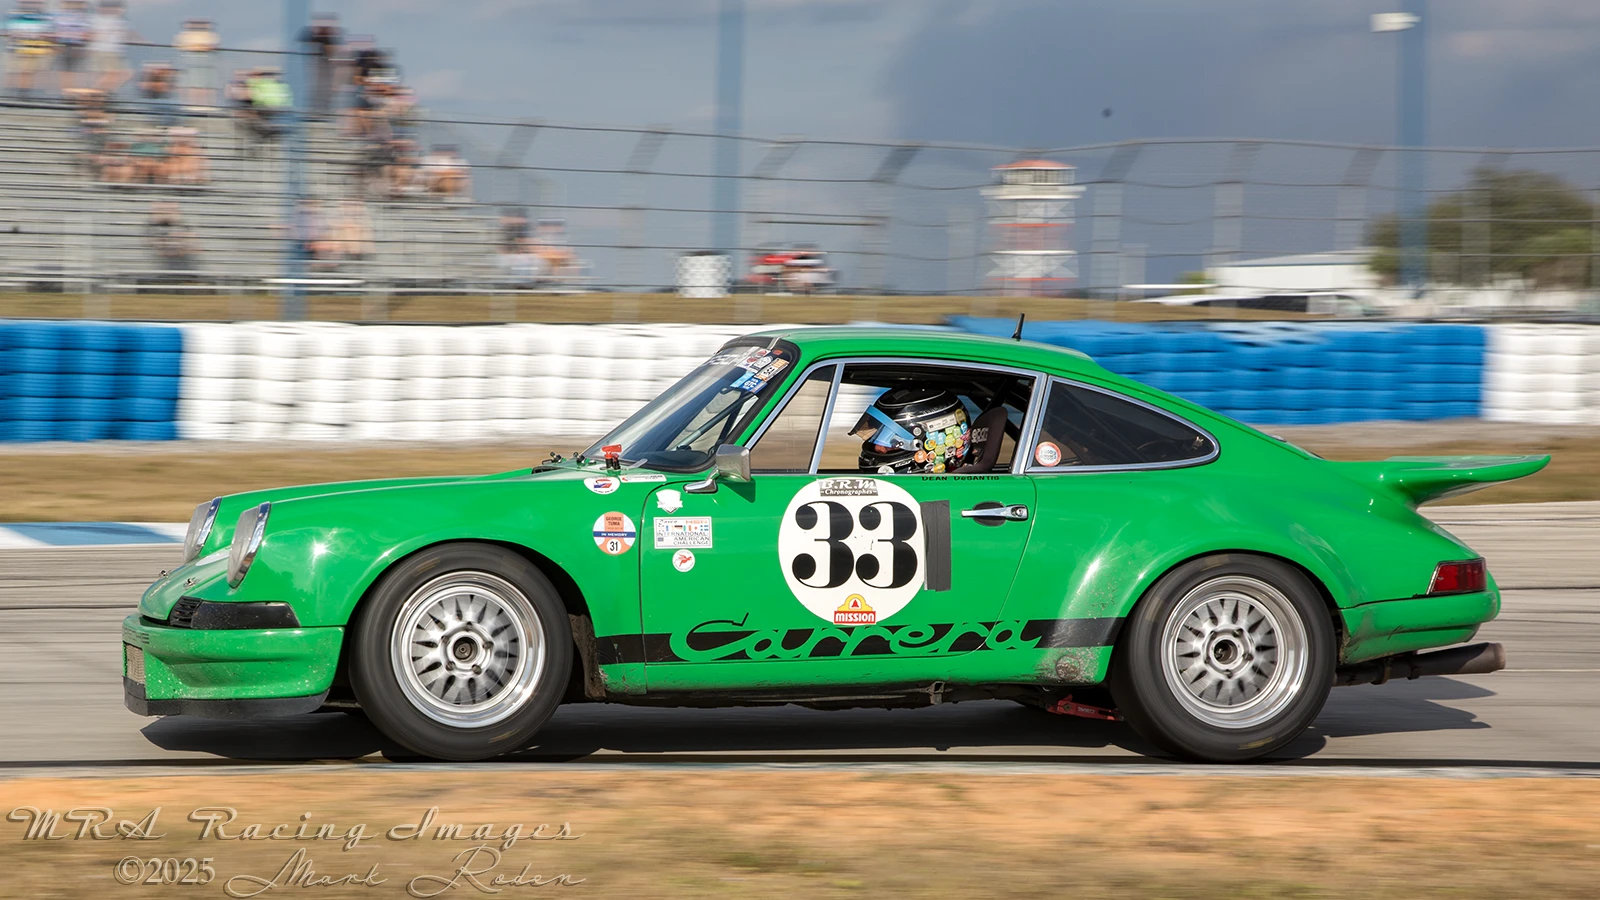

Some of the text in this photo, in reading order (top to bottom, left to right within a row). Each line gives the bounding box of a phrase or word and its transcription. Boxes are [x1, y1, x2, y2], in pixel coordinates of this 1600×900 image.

[609, 541, 618, 552] 31
[792, 500, 918, 589] 33
[835, 612, 875, 622] MISSION
[670, 613, 1043, 662] Carrera
